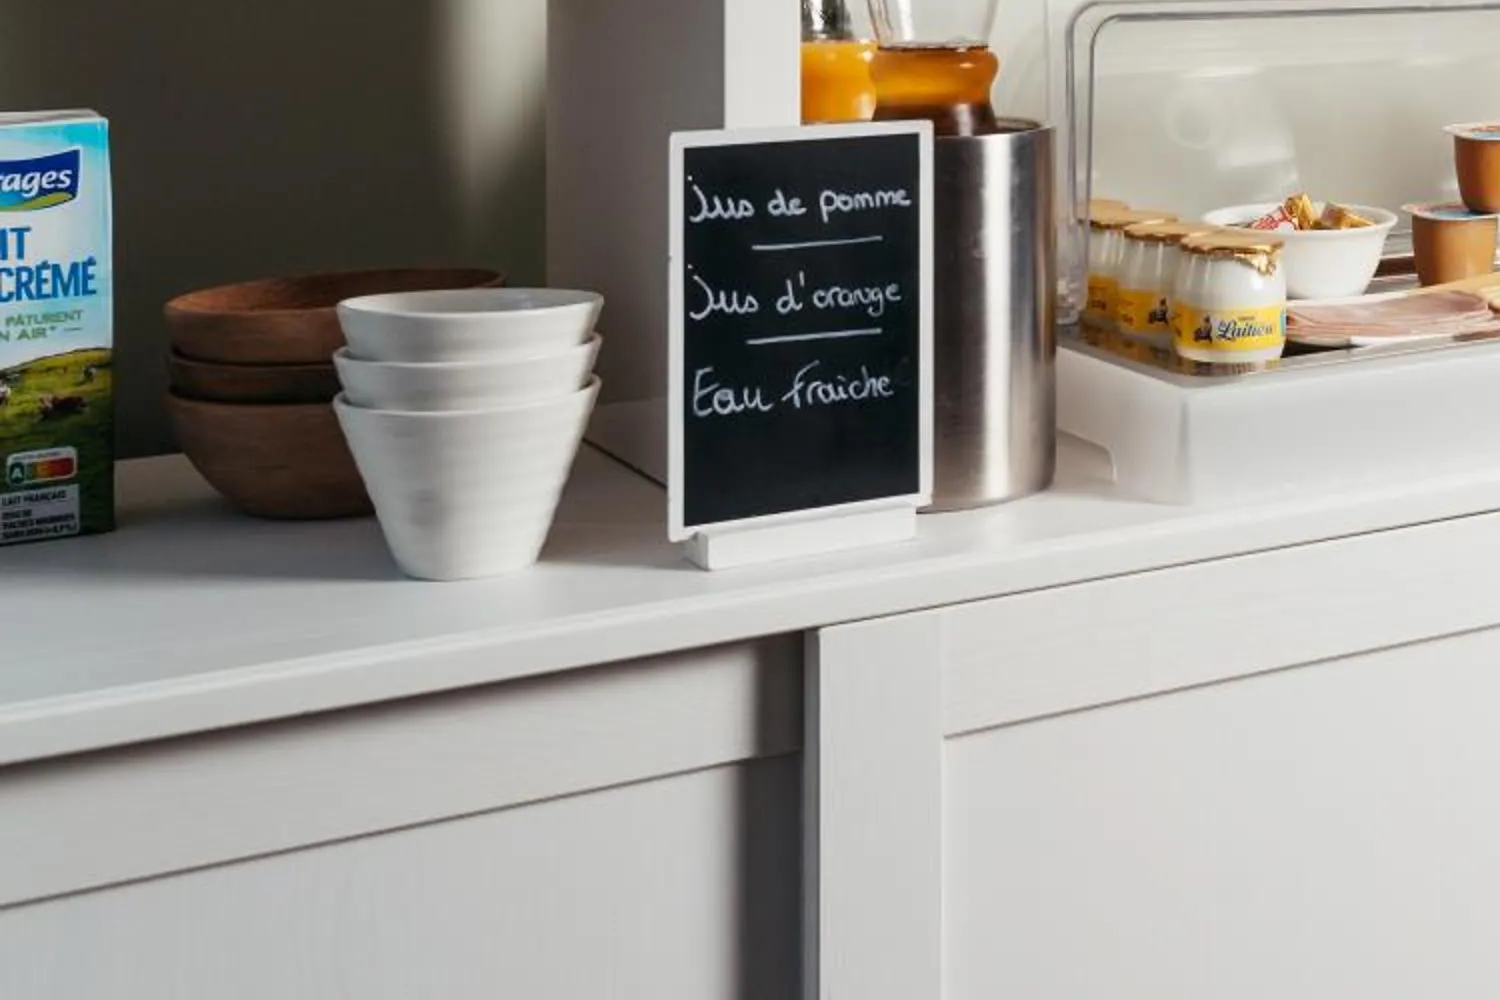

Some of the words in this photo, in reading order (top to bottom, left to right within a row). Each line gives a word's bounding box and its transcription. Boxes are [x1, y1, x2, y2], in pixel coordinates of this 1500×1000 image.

[767, 189, 807, 216] de
[819, 189, 912, 224] pomme
[693, 366, 772, 417] Eau
